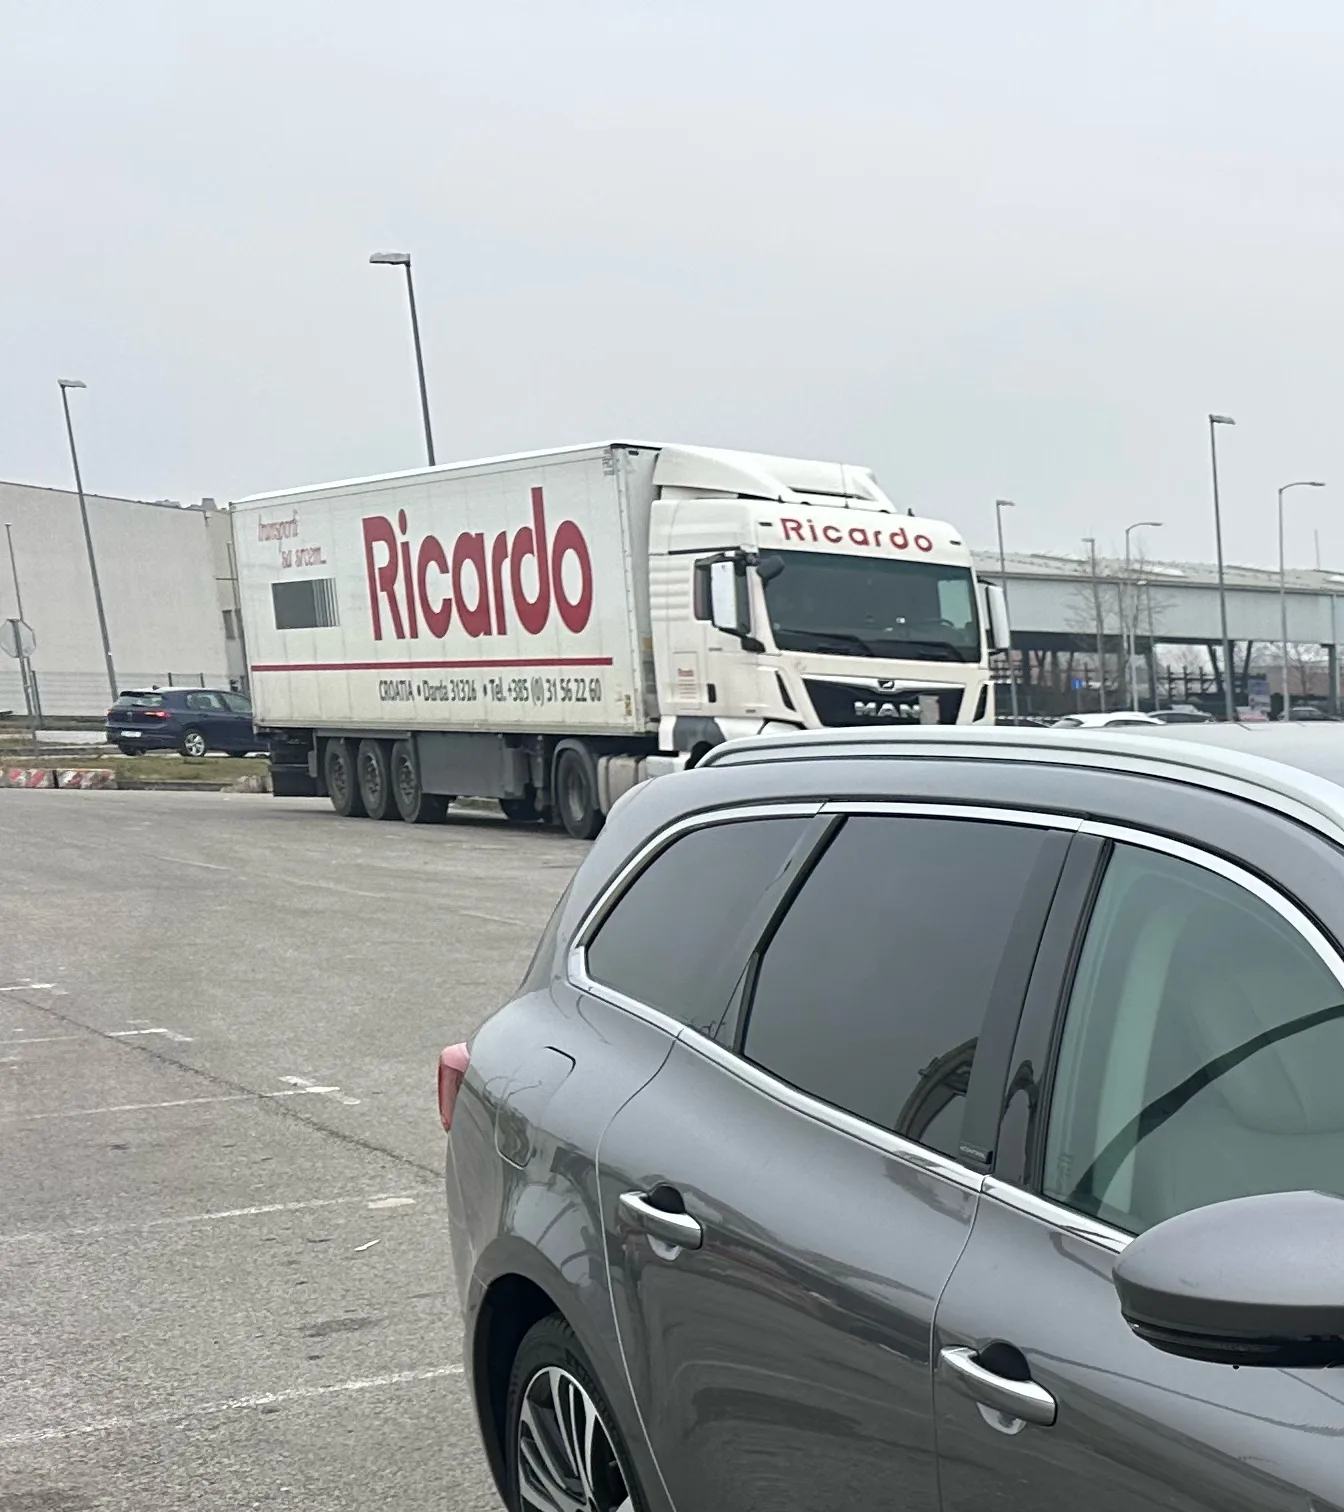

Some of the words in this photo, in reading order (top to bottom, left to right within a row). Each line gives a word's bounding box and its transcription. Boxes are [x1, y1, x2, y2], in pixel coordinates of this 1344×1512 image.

[780, 518, 933, 552] Ricardo
[362, 486, 593, 641] Ricardo
[574, 678, 587, 702] 22
[854, 701, 921, 719] MAN
